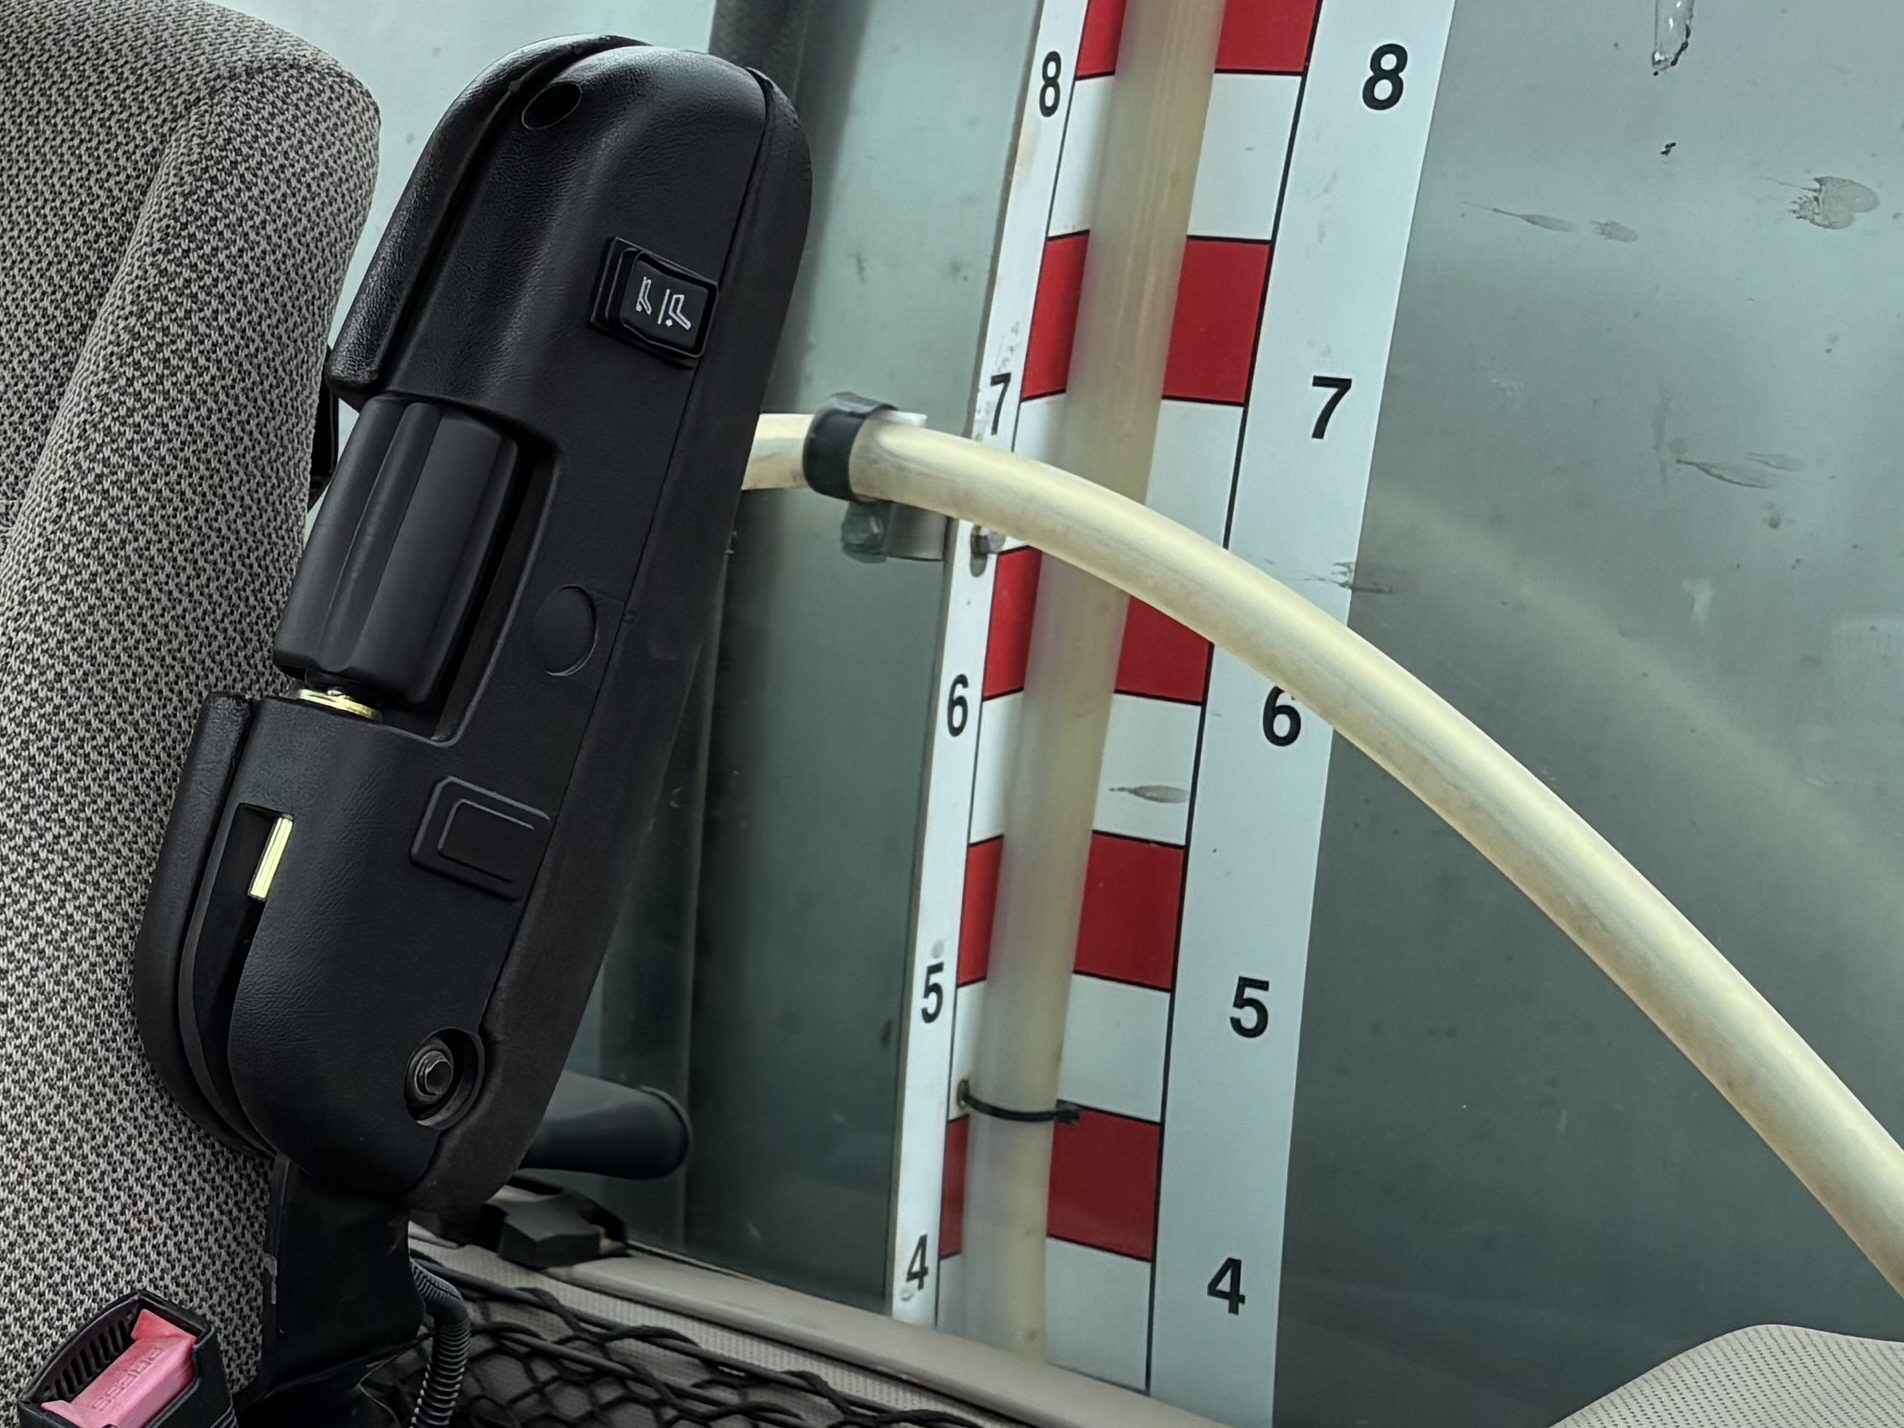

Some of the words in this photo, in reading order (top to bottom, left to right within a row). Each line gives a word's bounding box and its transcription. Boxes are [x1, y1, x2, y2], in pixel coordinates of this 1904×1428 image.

[1039, 50, 1062, 118] 8
[1362, 43, 1408, 111] 8
[990, 372, 1012, 435] 7
[1311, 375, 1353, 440] 7
[947, 674, 969, 737] 6
[1262, 686, 1302, 747] 6
[921, 962, 944, 1024] 5
[1229, 976, 1270, 1039] 5
[906, 1234, 929, 1291] 4
[1206, 1256, 1246, 1316] 4
[91, 1346, 166, 1413] PRESS
